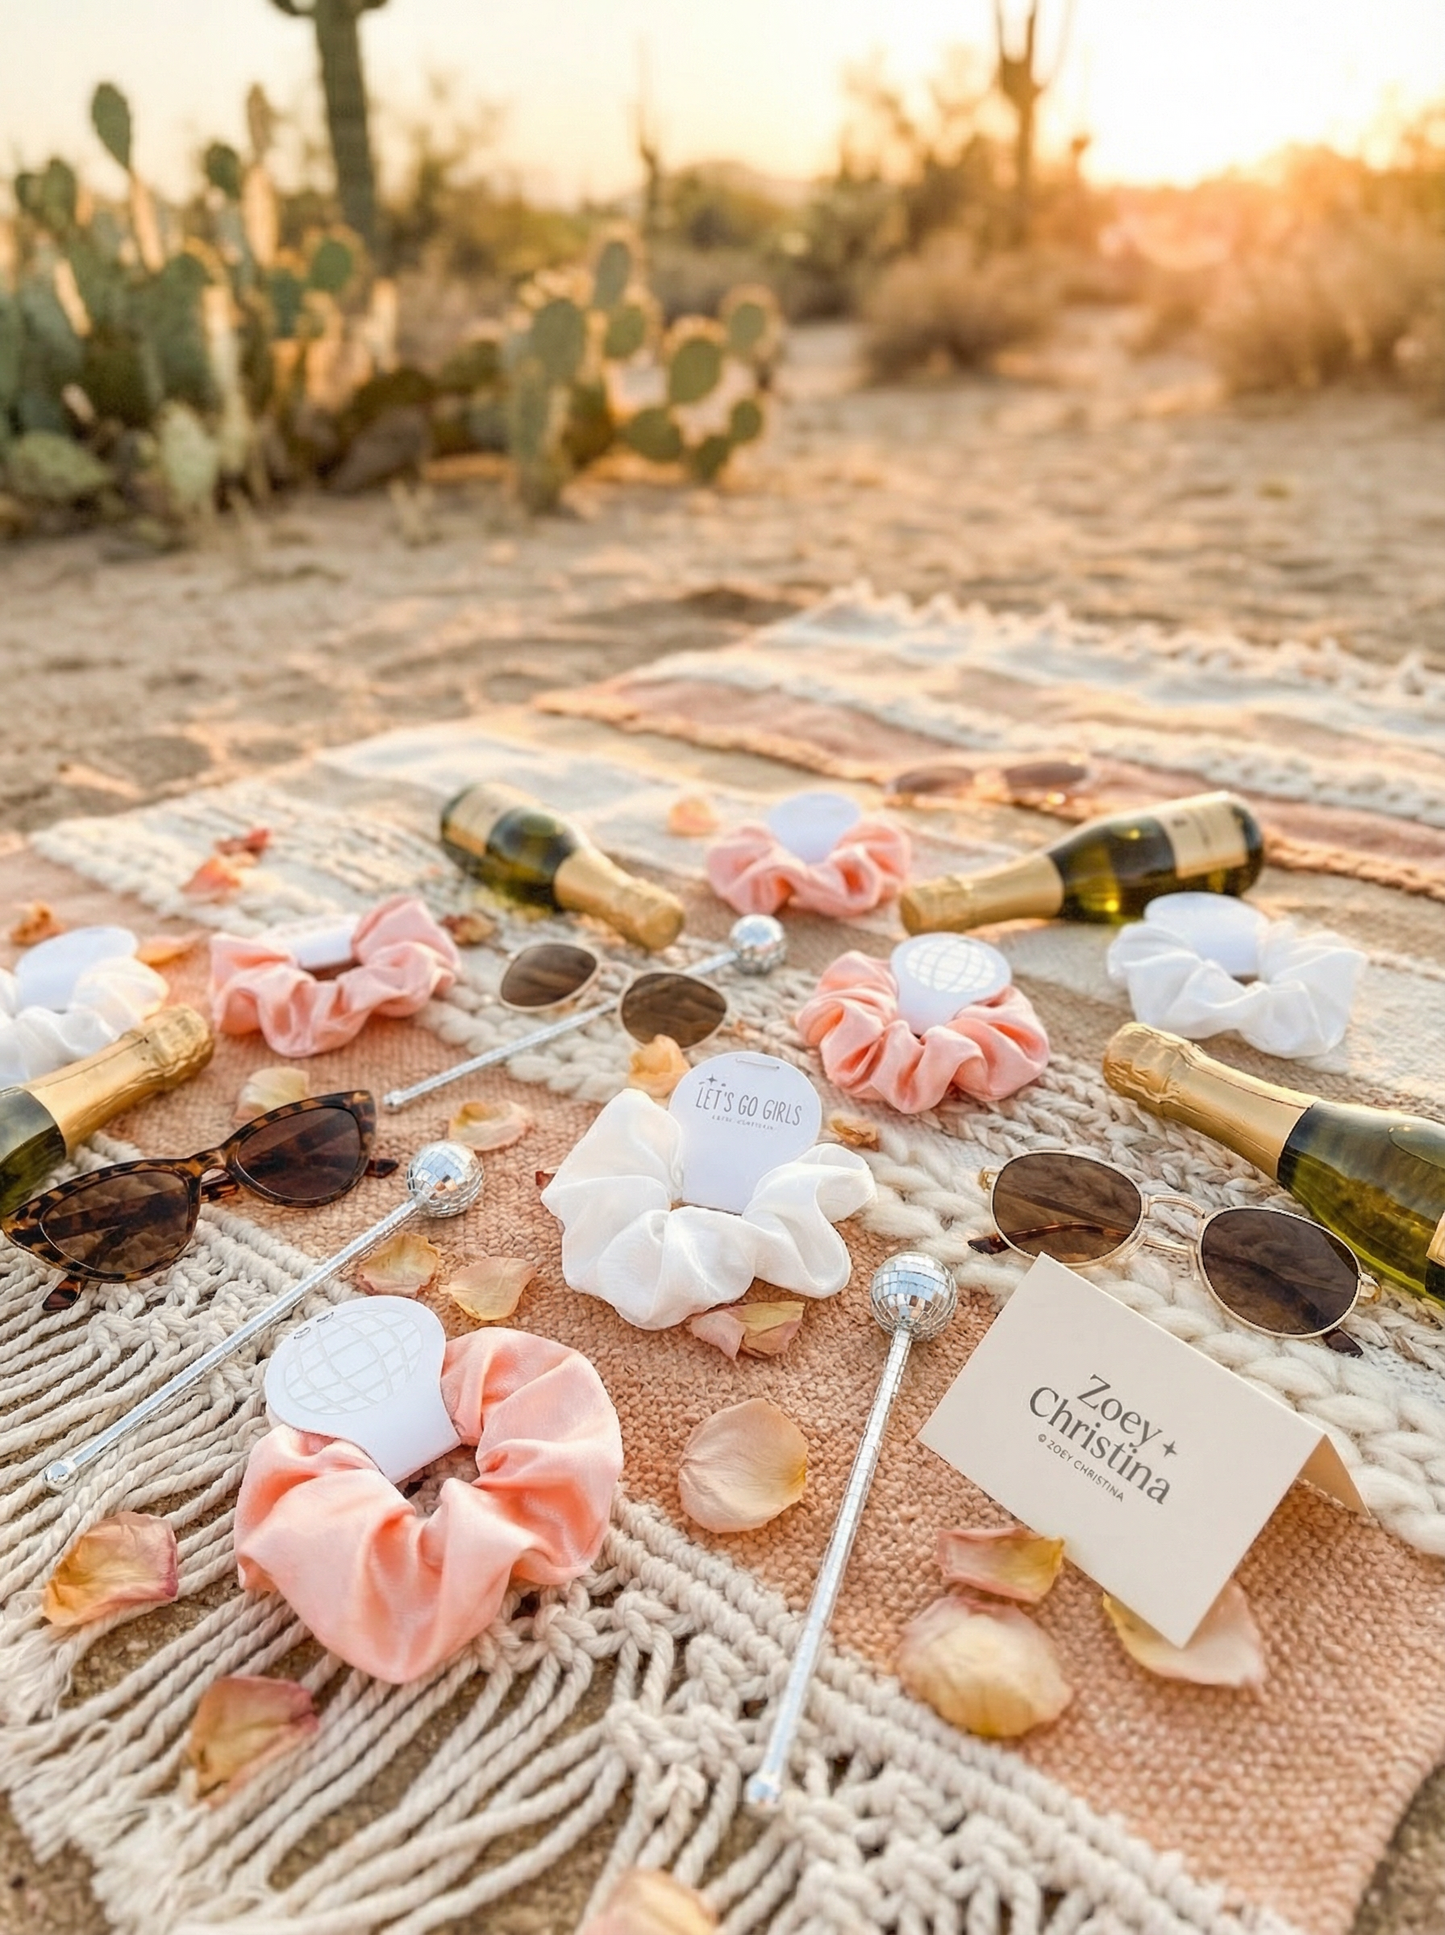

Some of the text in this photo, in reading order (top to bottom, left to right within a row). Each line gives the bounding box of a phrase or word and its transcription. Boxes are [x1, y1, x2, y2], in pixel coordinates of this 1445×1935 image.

[695, 1087, 735, 1113] LET'S
[738, 1095, 759, 1117] GO
[762, 1099, 802, 1126] GIRLS
[1077, 1374, 1163, 1448] Zoey
[1029, 1386, 1171, 1505] Christina
[1047, 1440, 1074, 1462] ZOEY
[1073, 1460, 1124, 1502] CHRISTINA
